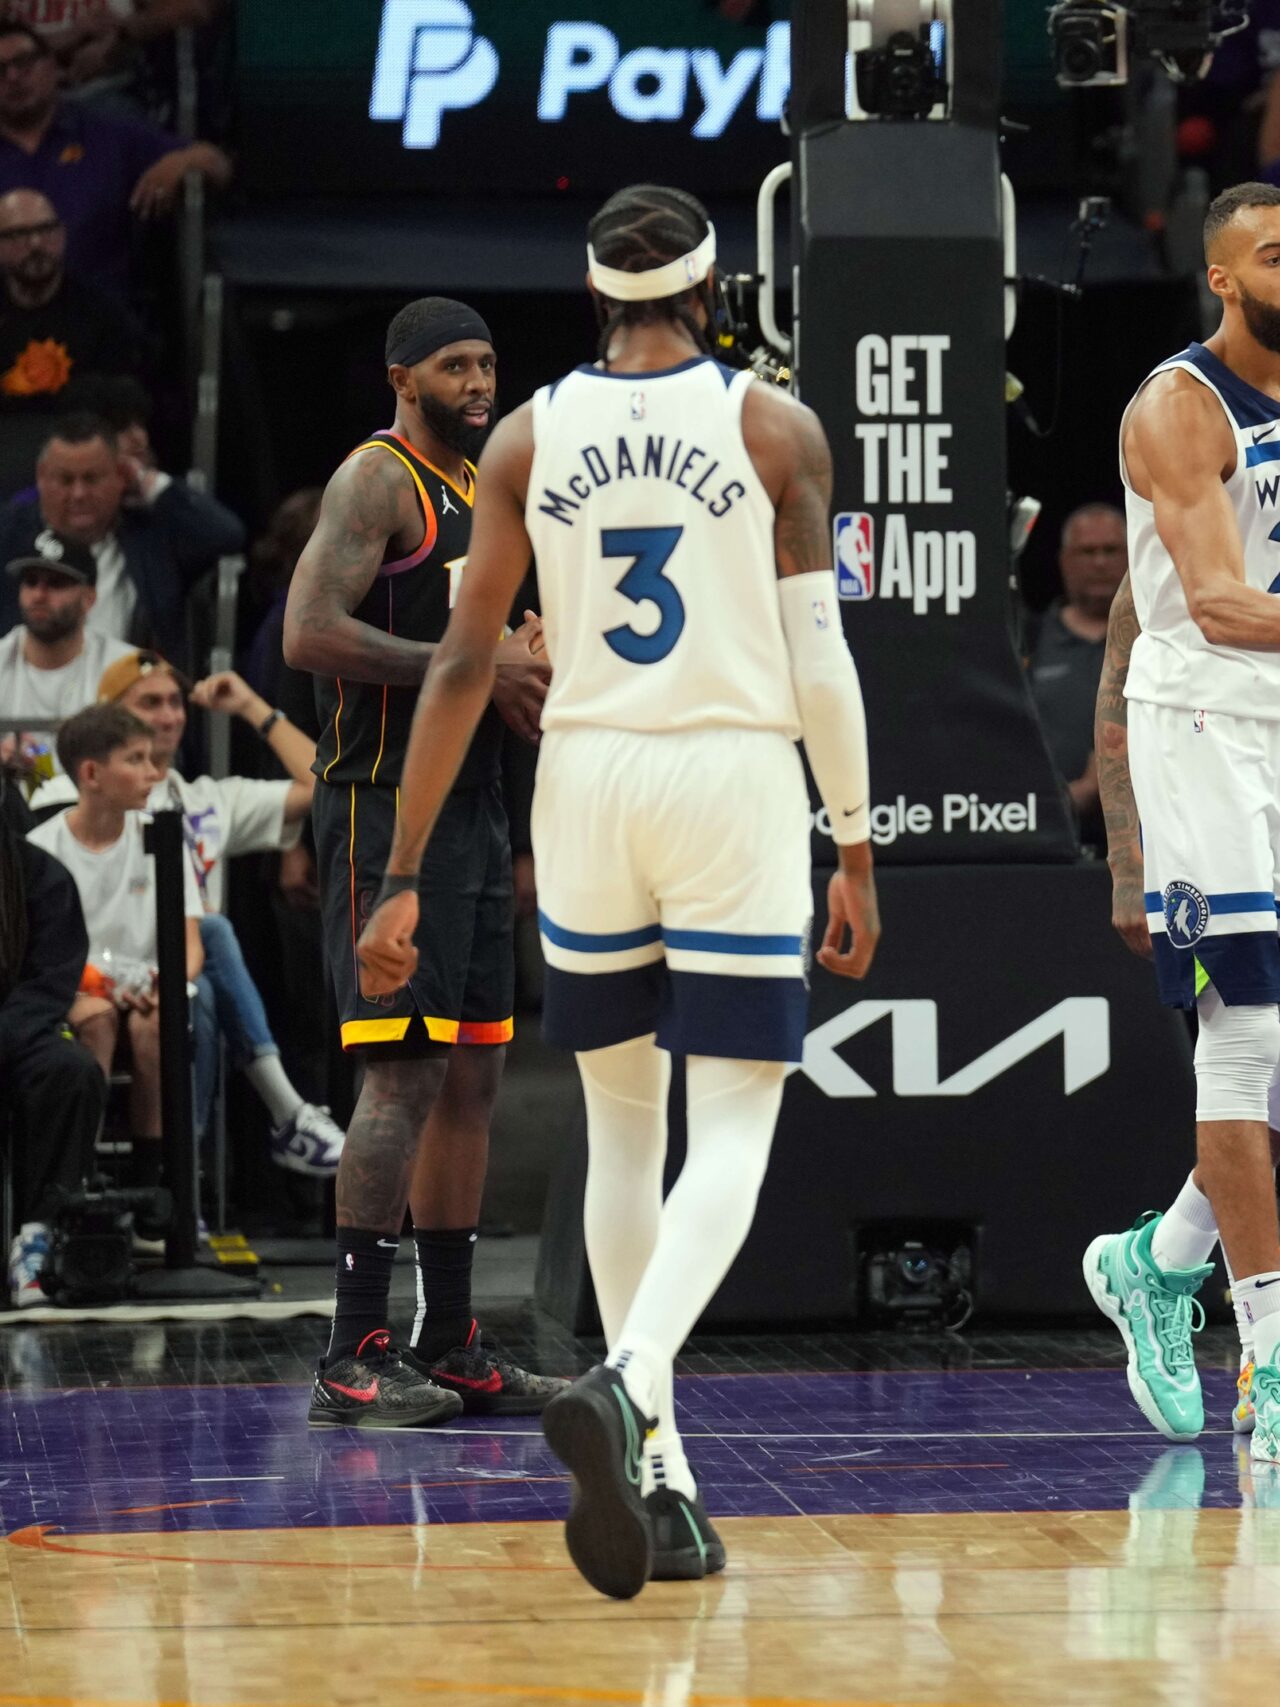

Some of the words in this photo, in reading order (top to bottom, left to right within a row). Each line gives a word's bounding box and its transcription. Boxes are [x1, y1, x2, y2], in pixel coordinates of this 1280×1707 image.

[855, 333, 951, 416] GET
[538, 435, 746, 527] McDANIELS
[854, 423, 953, 504] THE
[600, 525, 686, 665] 3
[879, 513, 977, 616] App
[942, 792, 1037, 834] Pixel
